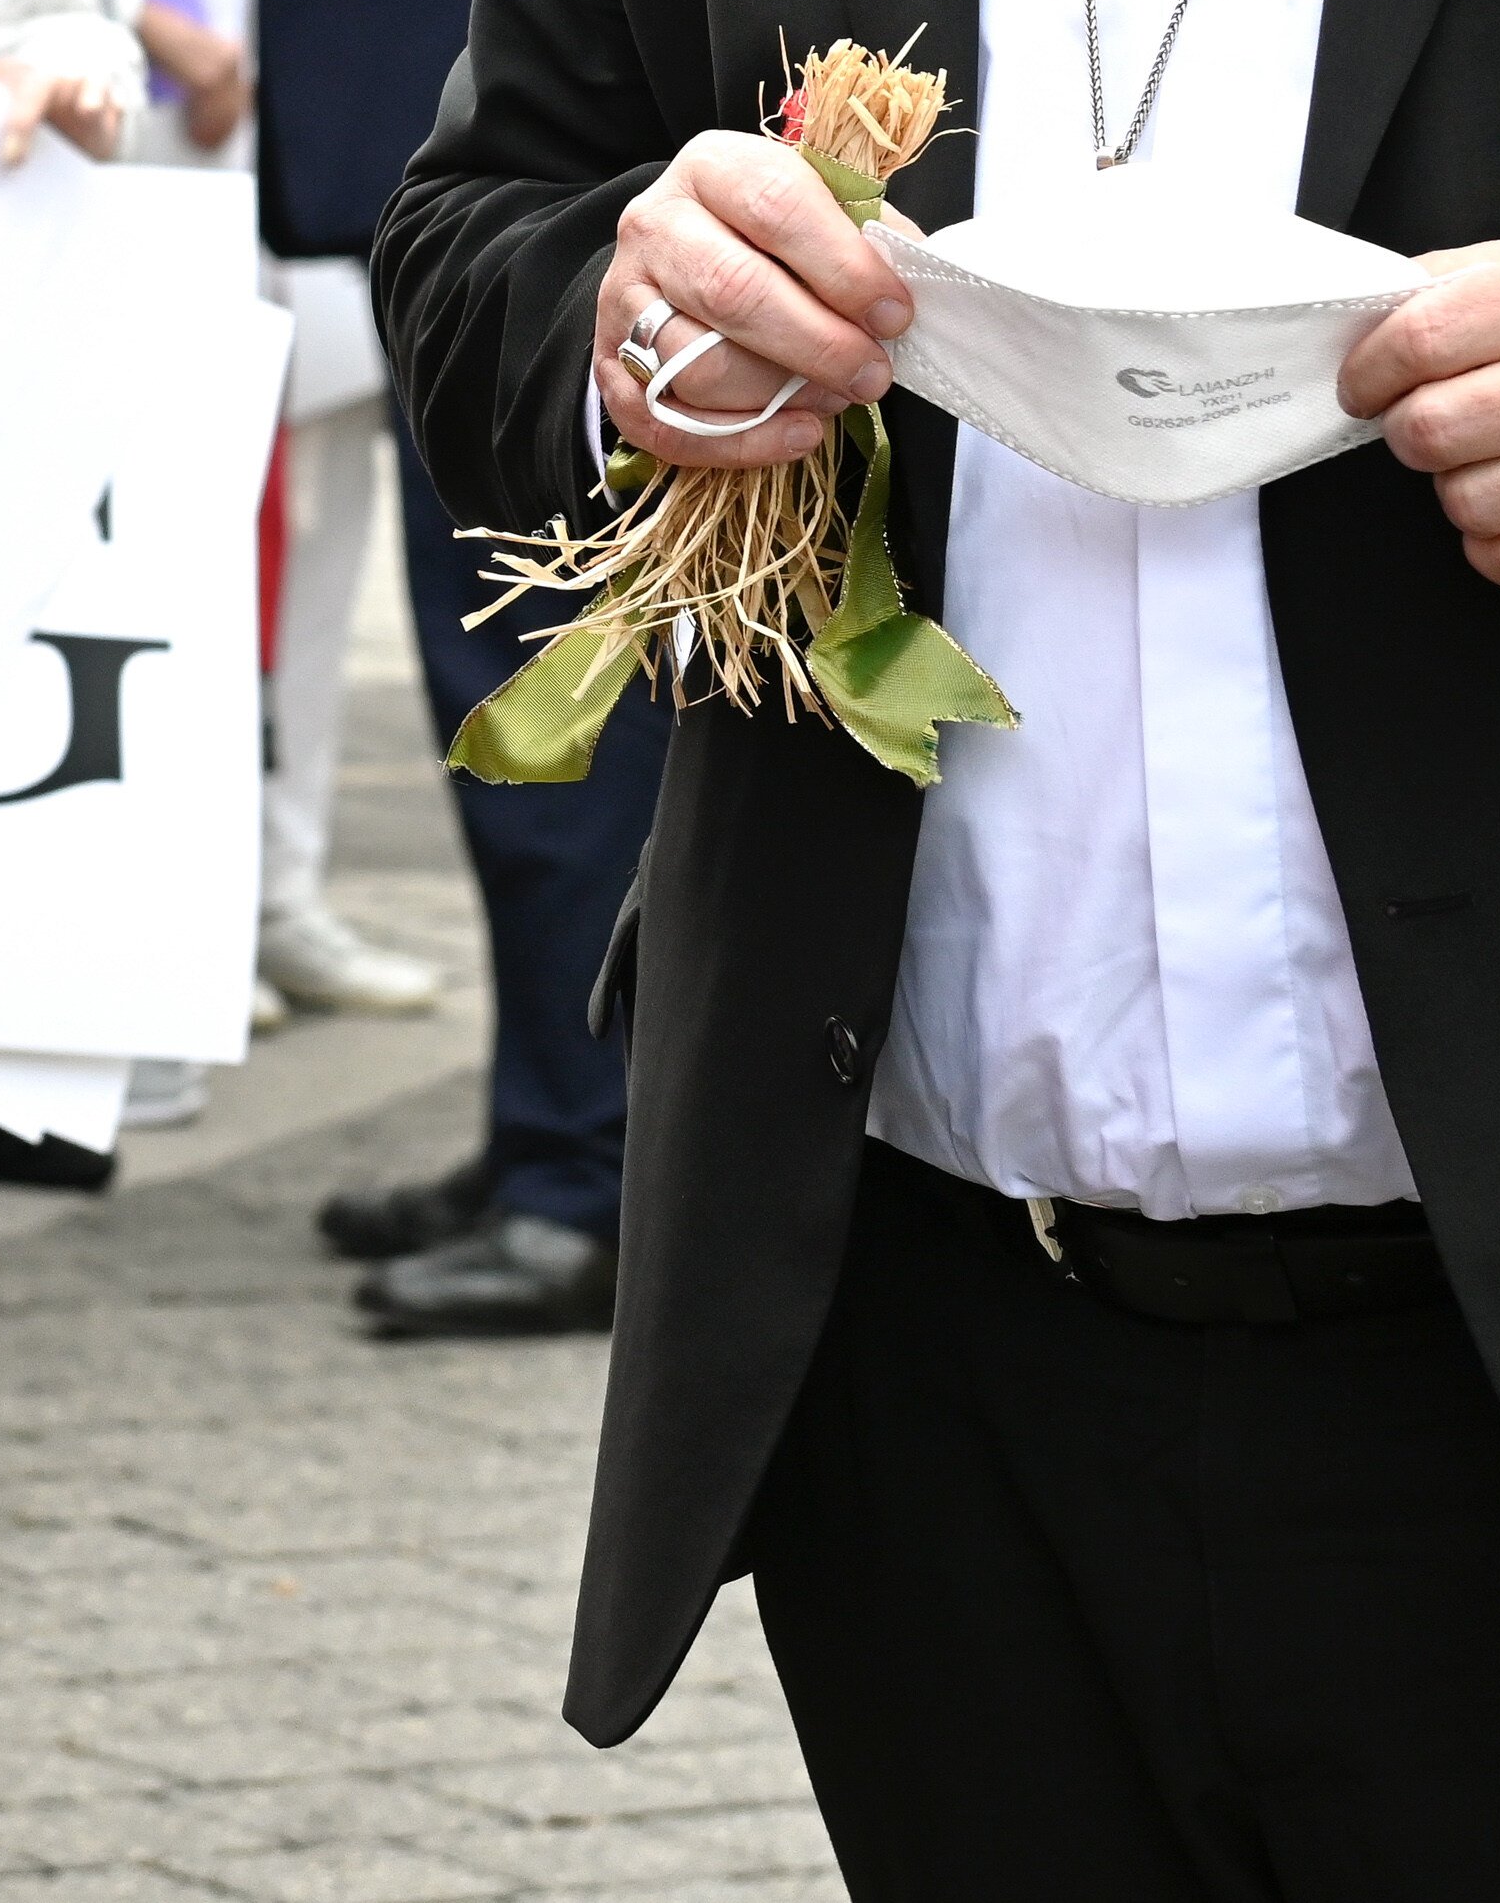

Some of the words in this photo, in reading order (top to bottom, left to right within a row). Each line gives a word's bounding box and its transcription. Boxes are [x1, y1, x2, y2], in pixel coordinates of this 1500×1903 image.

[1178, 366, 1275, 397] LAIANZHI
[1127, 404, 1241, 429] GB2626-2006
[1246, 391, 1293, 410] KN95
